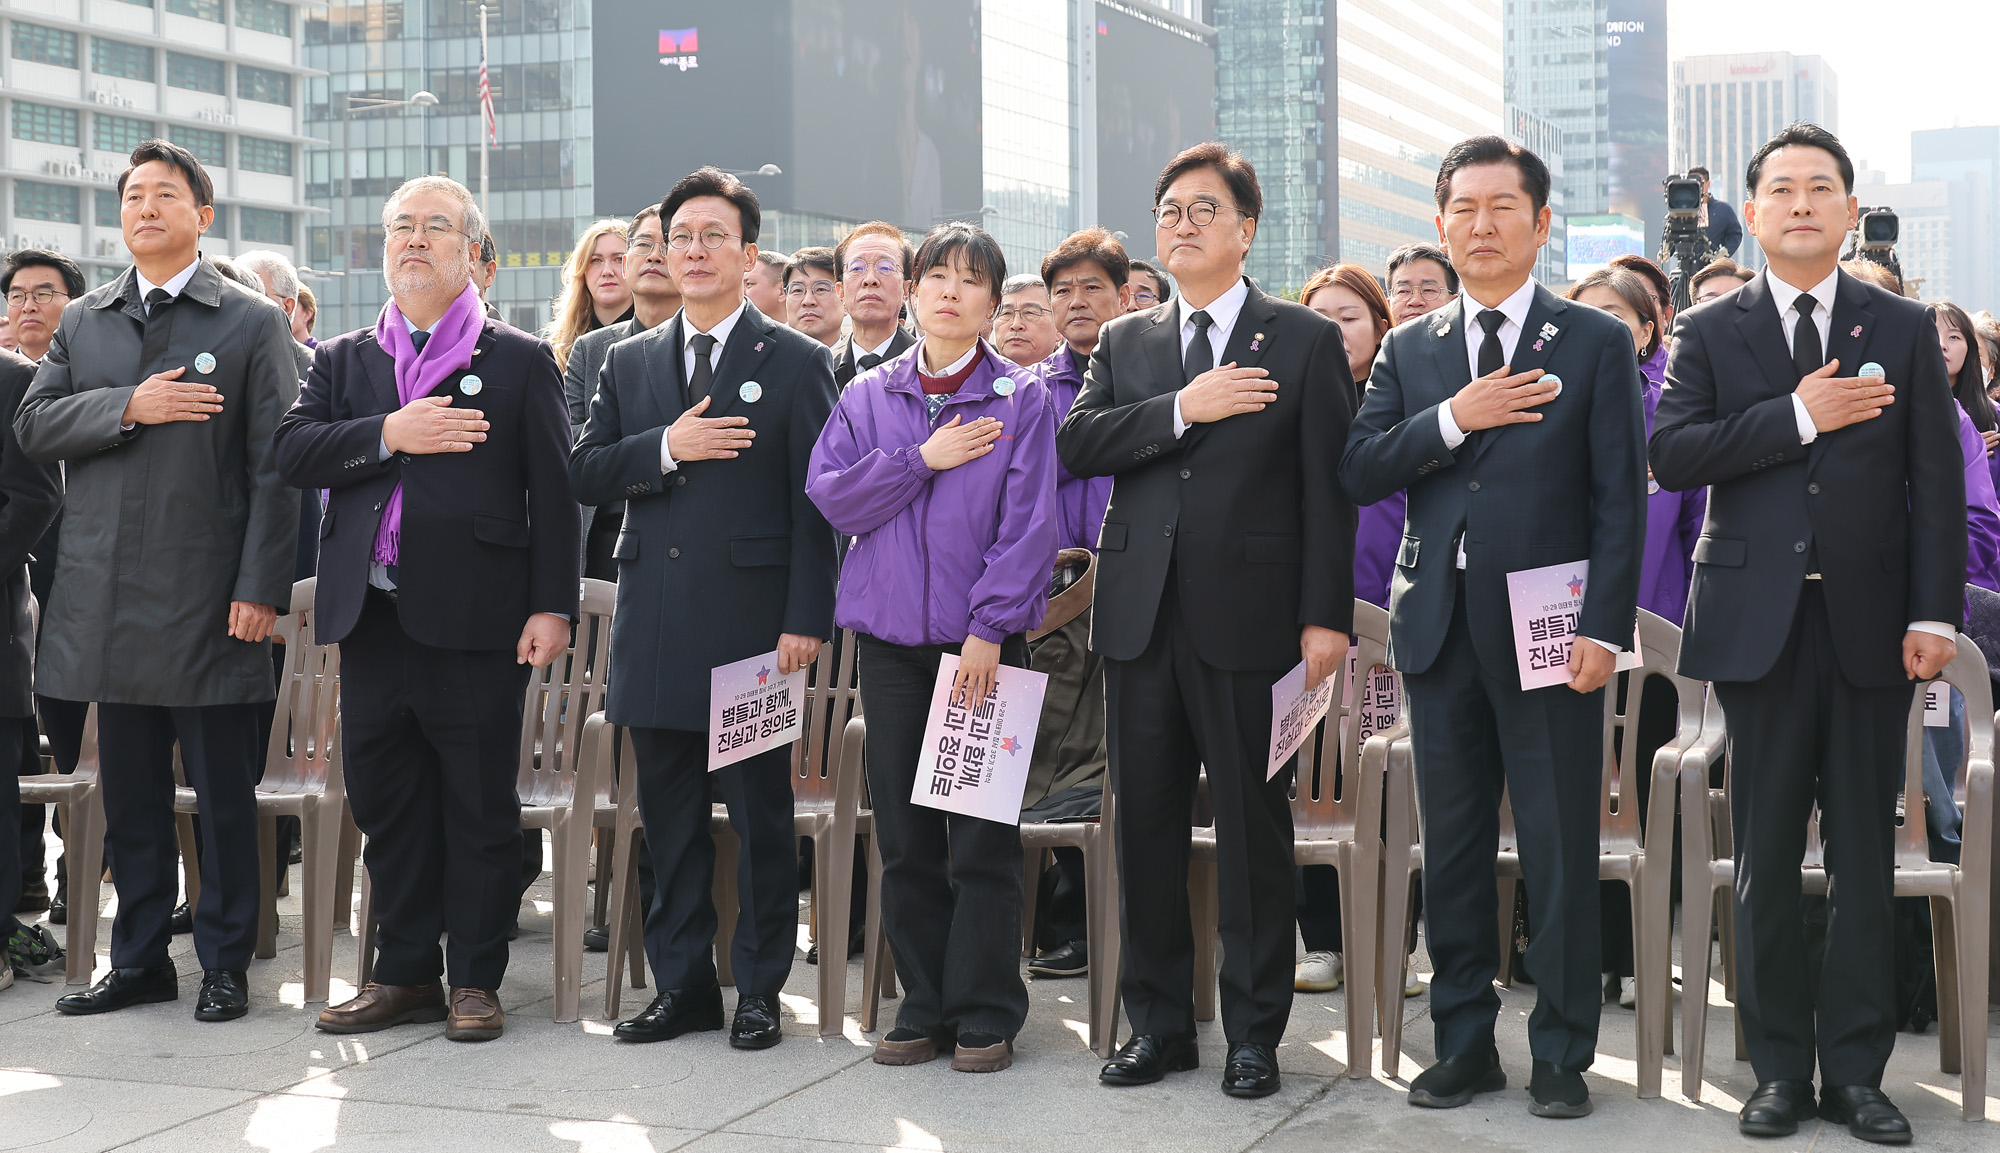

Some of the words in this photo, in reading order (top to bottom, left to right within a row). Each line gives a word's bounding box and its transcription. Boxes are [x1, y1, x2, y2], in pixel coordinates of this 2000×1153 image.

[1542, 603, 1557, 613] 10-29
[722, 698, 762, 729] 별들과
[765, 687, 792, 715] 함께,
[998, 700, 1007, 718] 10-29
[718, 722, 758, 754] 진실과
[760, 708, 797, 739] 정의로
[1274, 718, 1304, 762] 진실과
[929, 735, 962, 797] 정의로
[953, 745, 986, 791] 함께,
